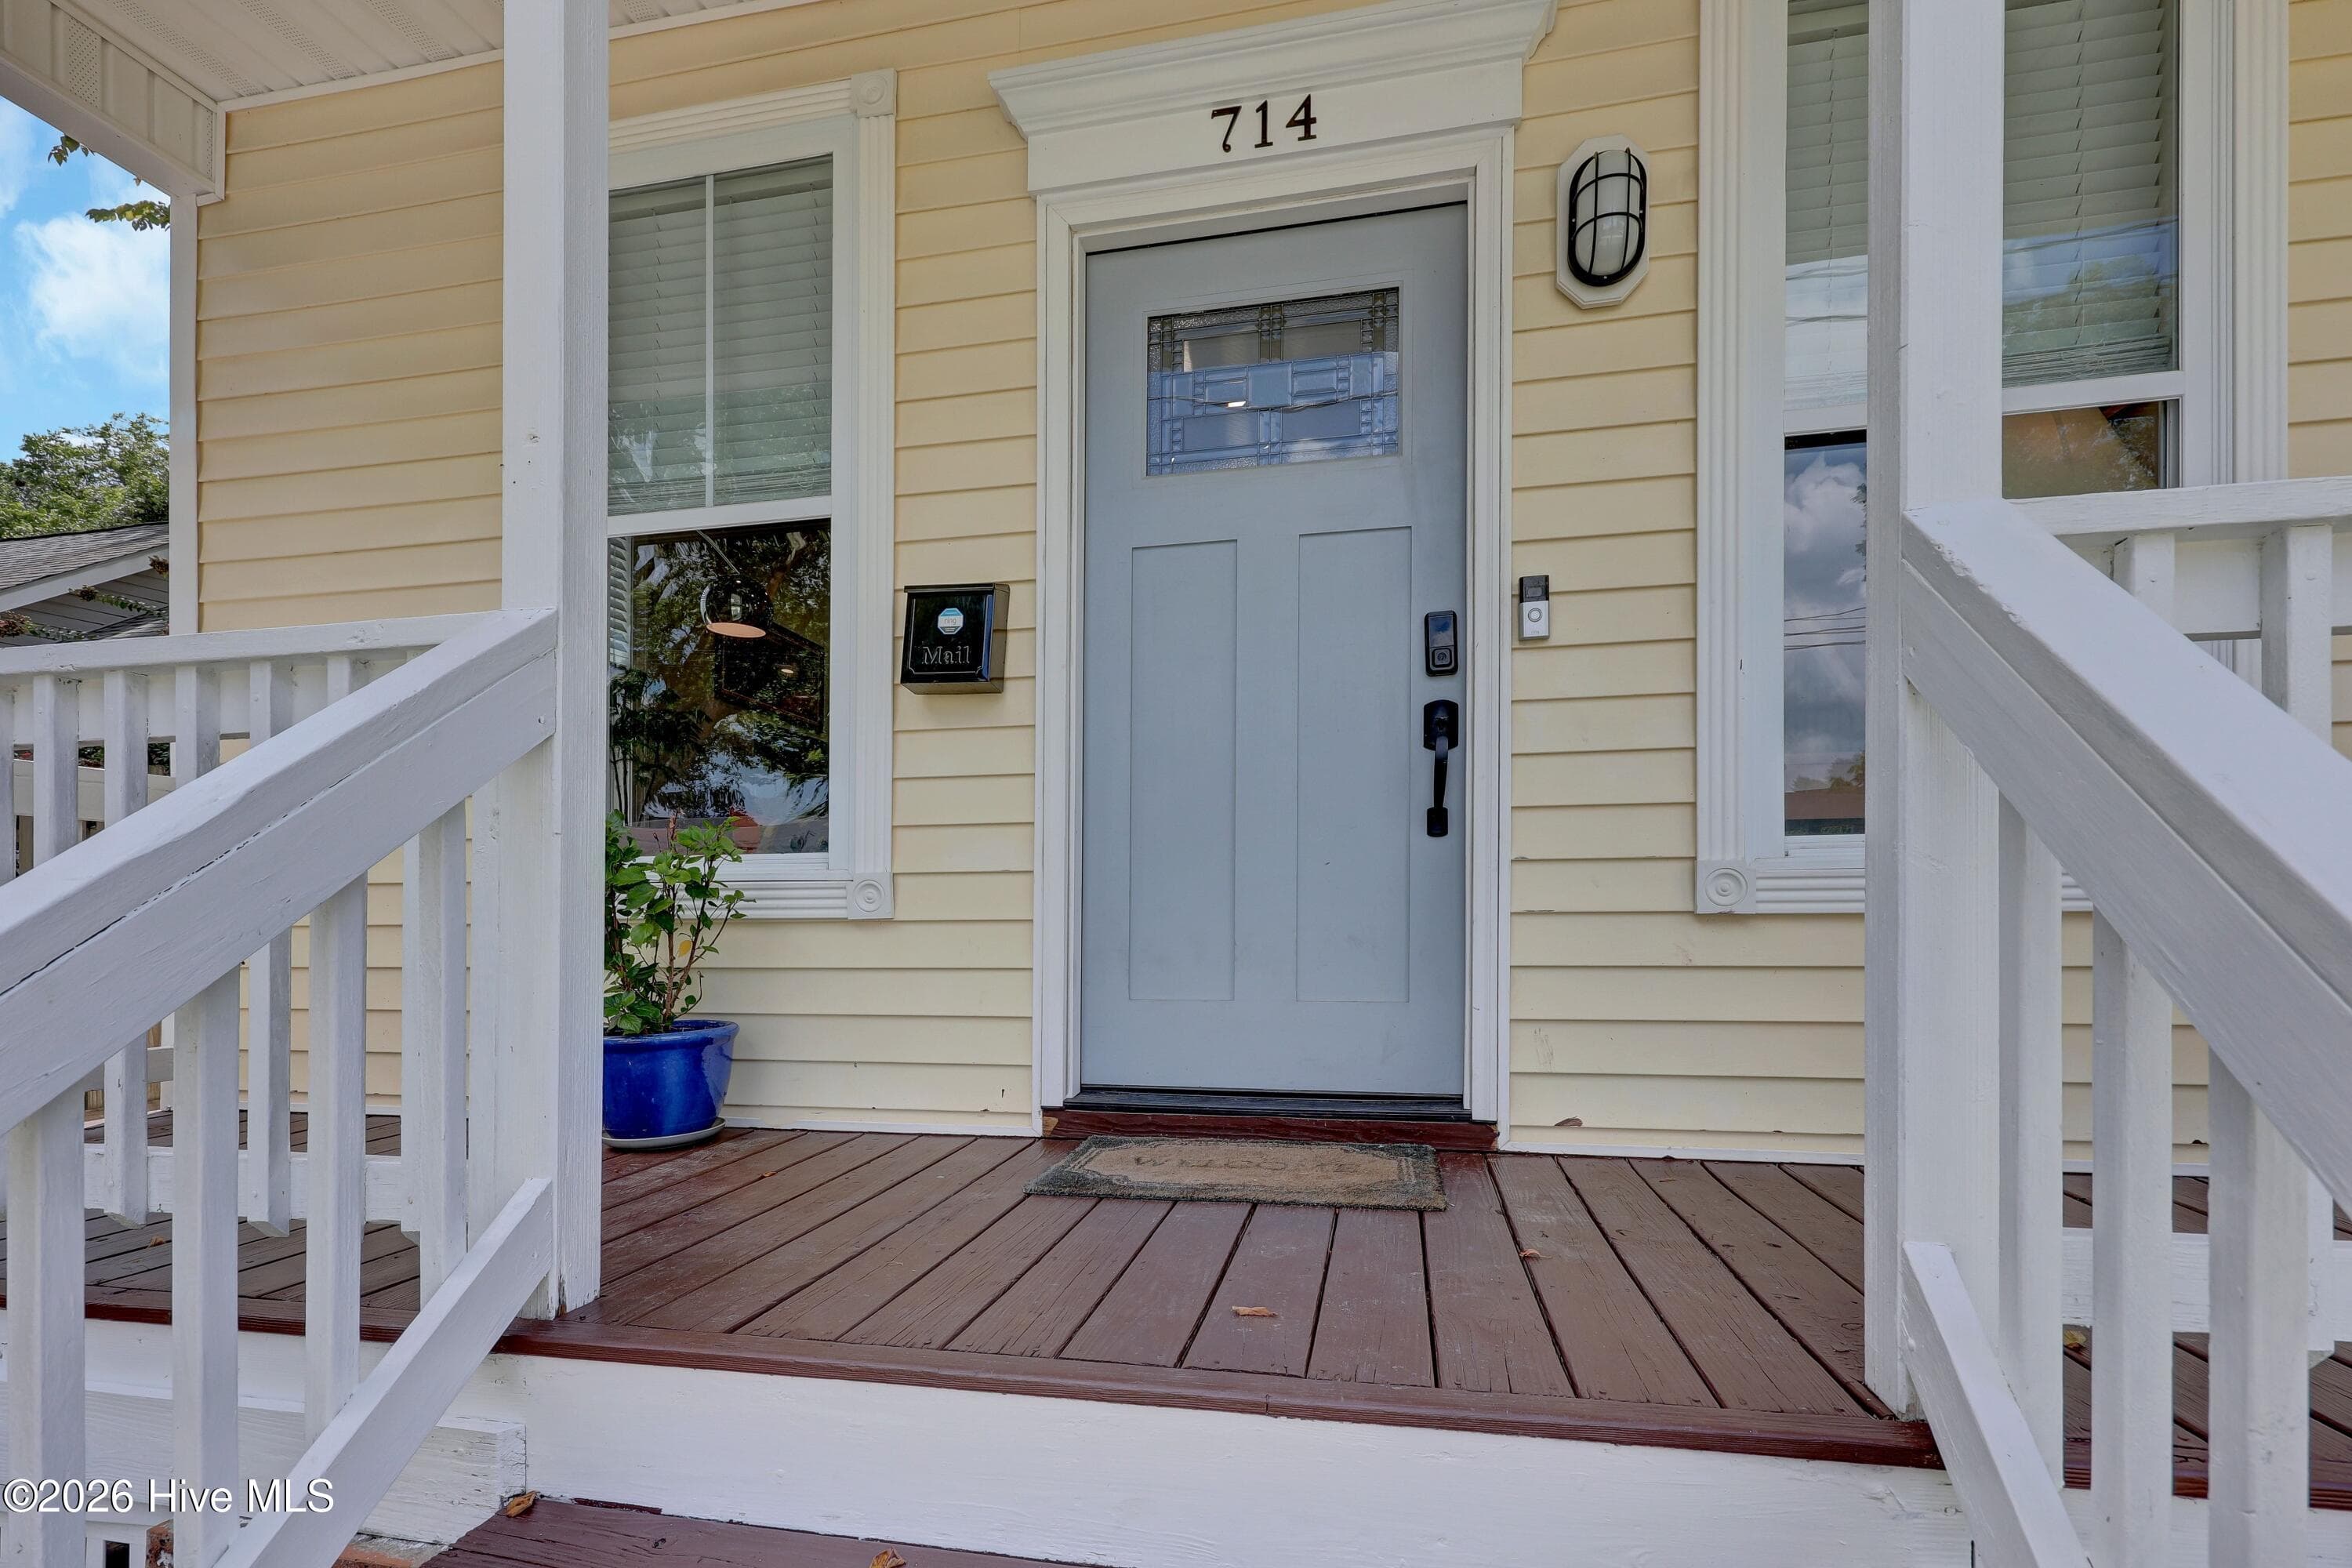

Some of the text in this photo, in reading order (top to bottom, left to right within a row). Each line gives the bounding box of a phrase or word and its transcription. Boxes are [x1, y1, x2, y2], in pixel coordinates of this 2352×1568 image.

[1210, 93, 1317, 153] 714
[944, 617, 956, 626] ring
[922, 645, 970, 664] Mail
[1135, 1156, 1361, 1174] WELCOE
